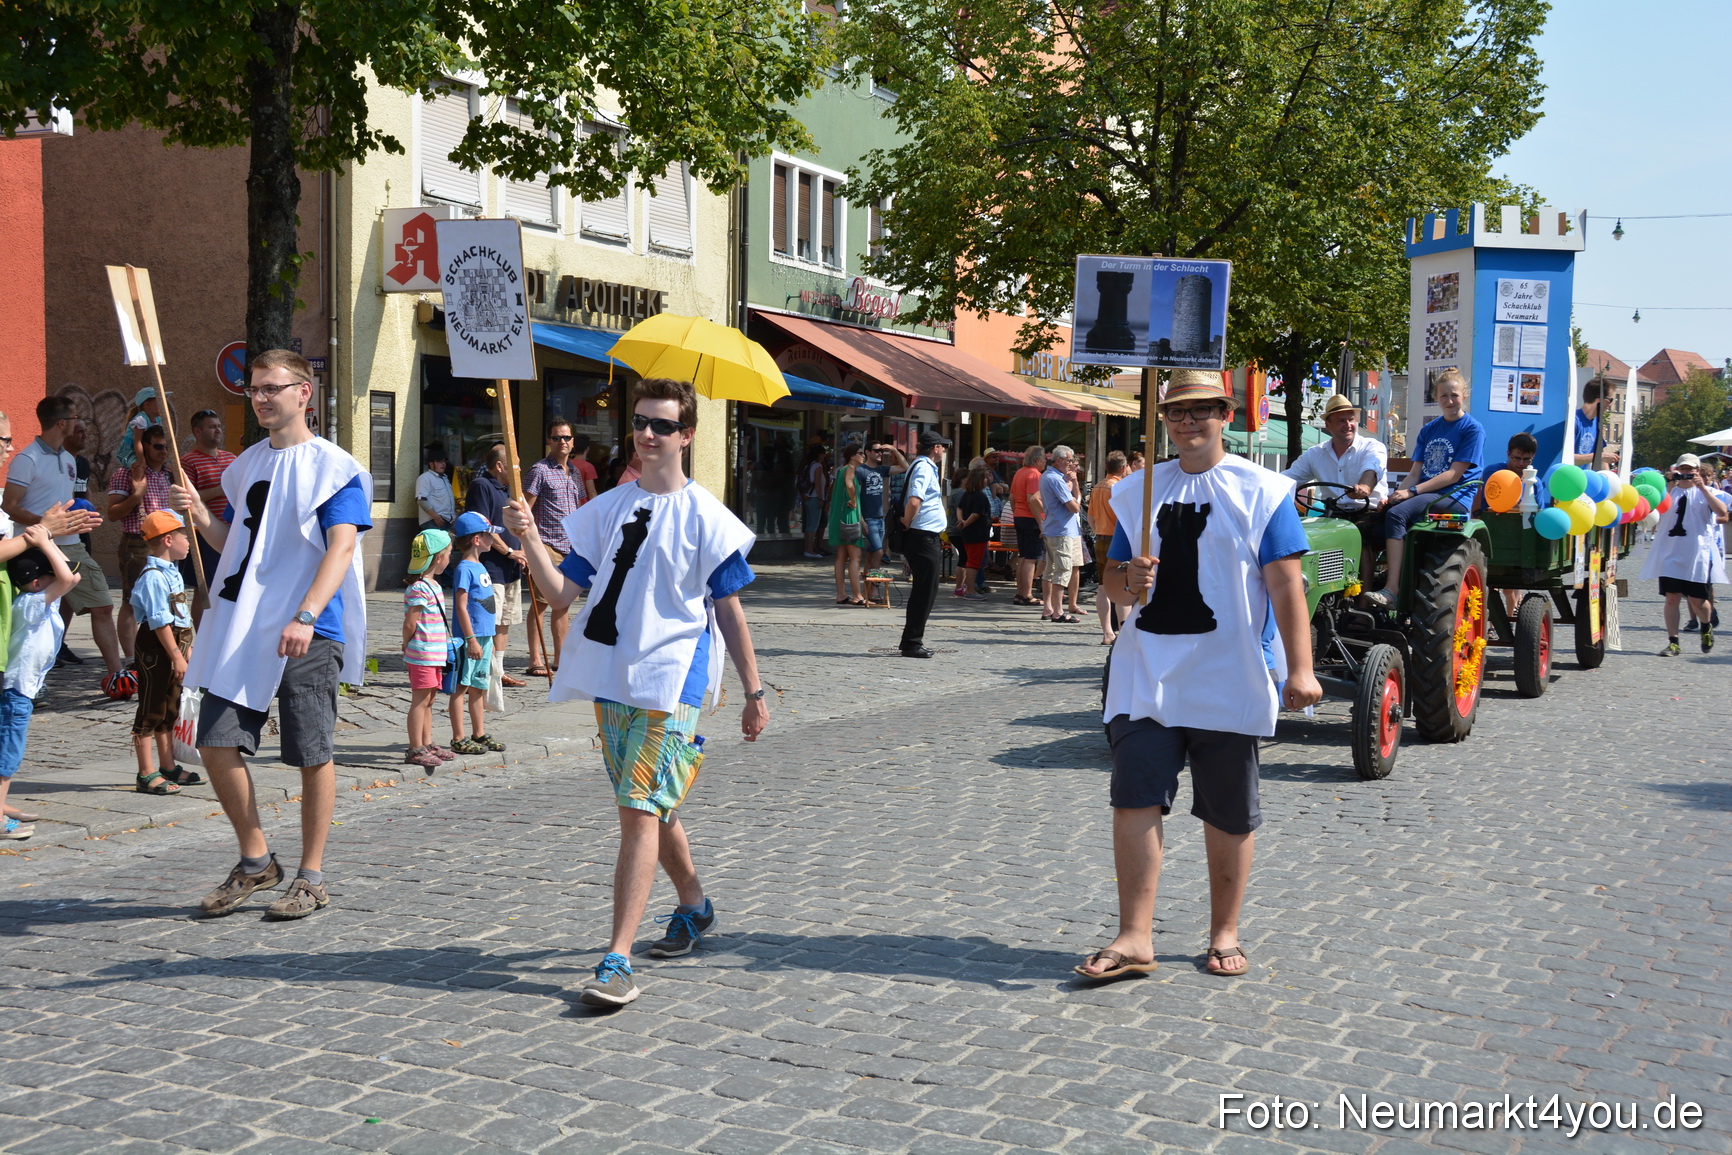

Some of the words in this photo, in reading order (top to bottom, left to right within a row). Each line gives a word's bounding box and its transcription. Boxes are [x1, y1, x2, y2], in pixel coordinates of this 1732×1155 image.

[445, 245, 518, 286] SCHACHKLUB
[1101, 261, 1116, 269] Der
[1119, 261, 1141, 270] Turm
[1143, 262, 1152, 271] in
[1154, 263, 1169, 272] der
[1171, 264, 1209, 273] Schlacht
[1519, 282, 1529, 290] 65
[562, 275, 669, 319] APOTHEKE
[844, 276, 904, 321] Bögerl
[1513, 292, 1533, 300] Jahre
[1502, 302, 1542, 310] Schachklub
[1505, 312, 1539, 320] Neumarkt
[448, 311, 513, 354] NEUMARKT
[511, 314, 525, 336] E.V.
[1169, 355, 1197, 363] Neumarkt
